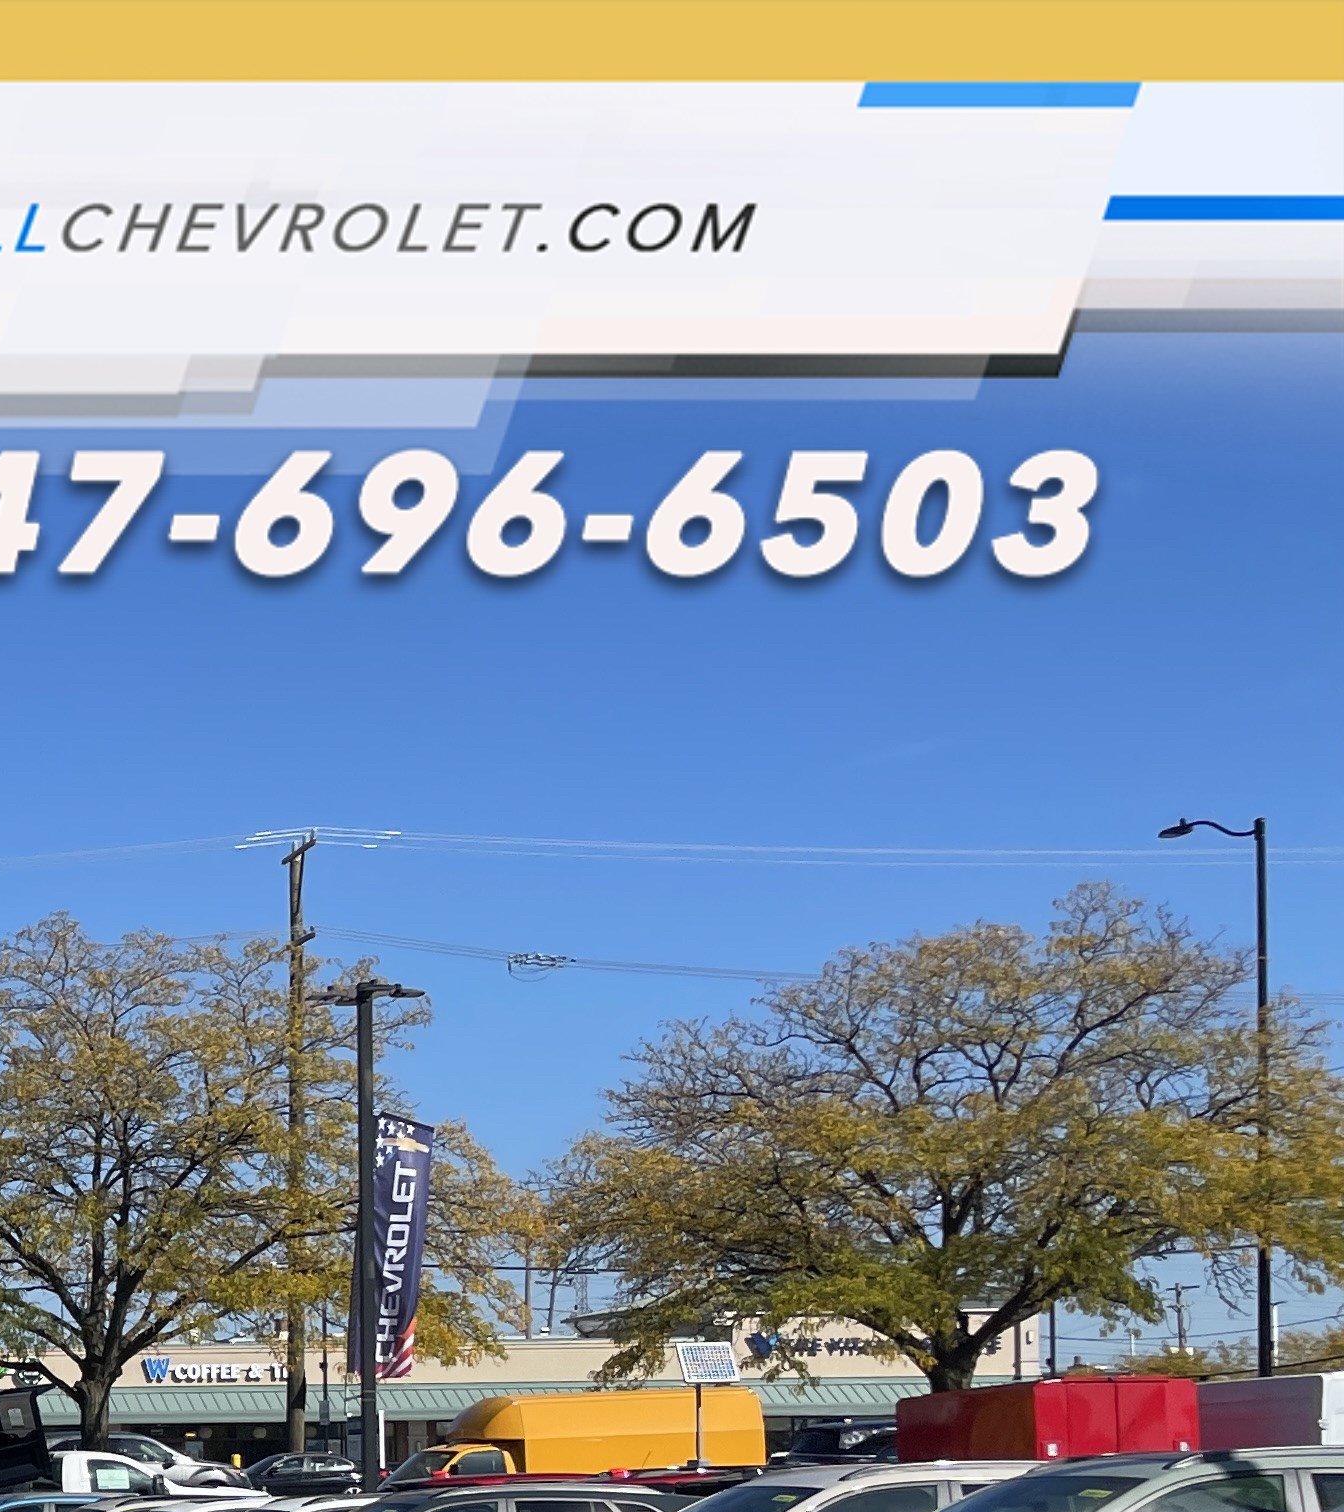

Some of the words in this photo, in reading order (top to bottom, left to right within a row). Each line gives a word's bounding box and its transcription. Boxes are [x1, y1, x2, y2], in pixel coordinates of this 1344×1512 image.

[375, 1161, 417, 1363] CHEVROLET
[174, 1363, 241, 1380] COFFEE
[248, 1364, 262, 1380] &
